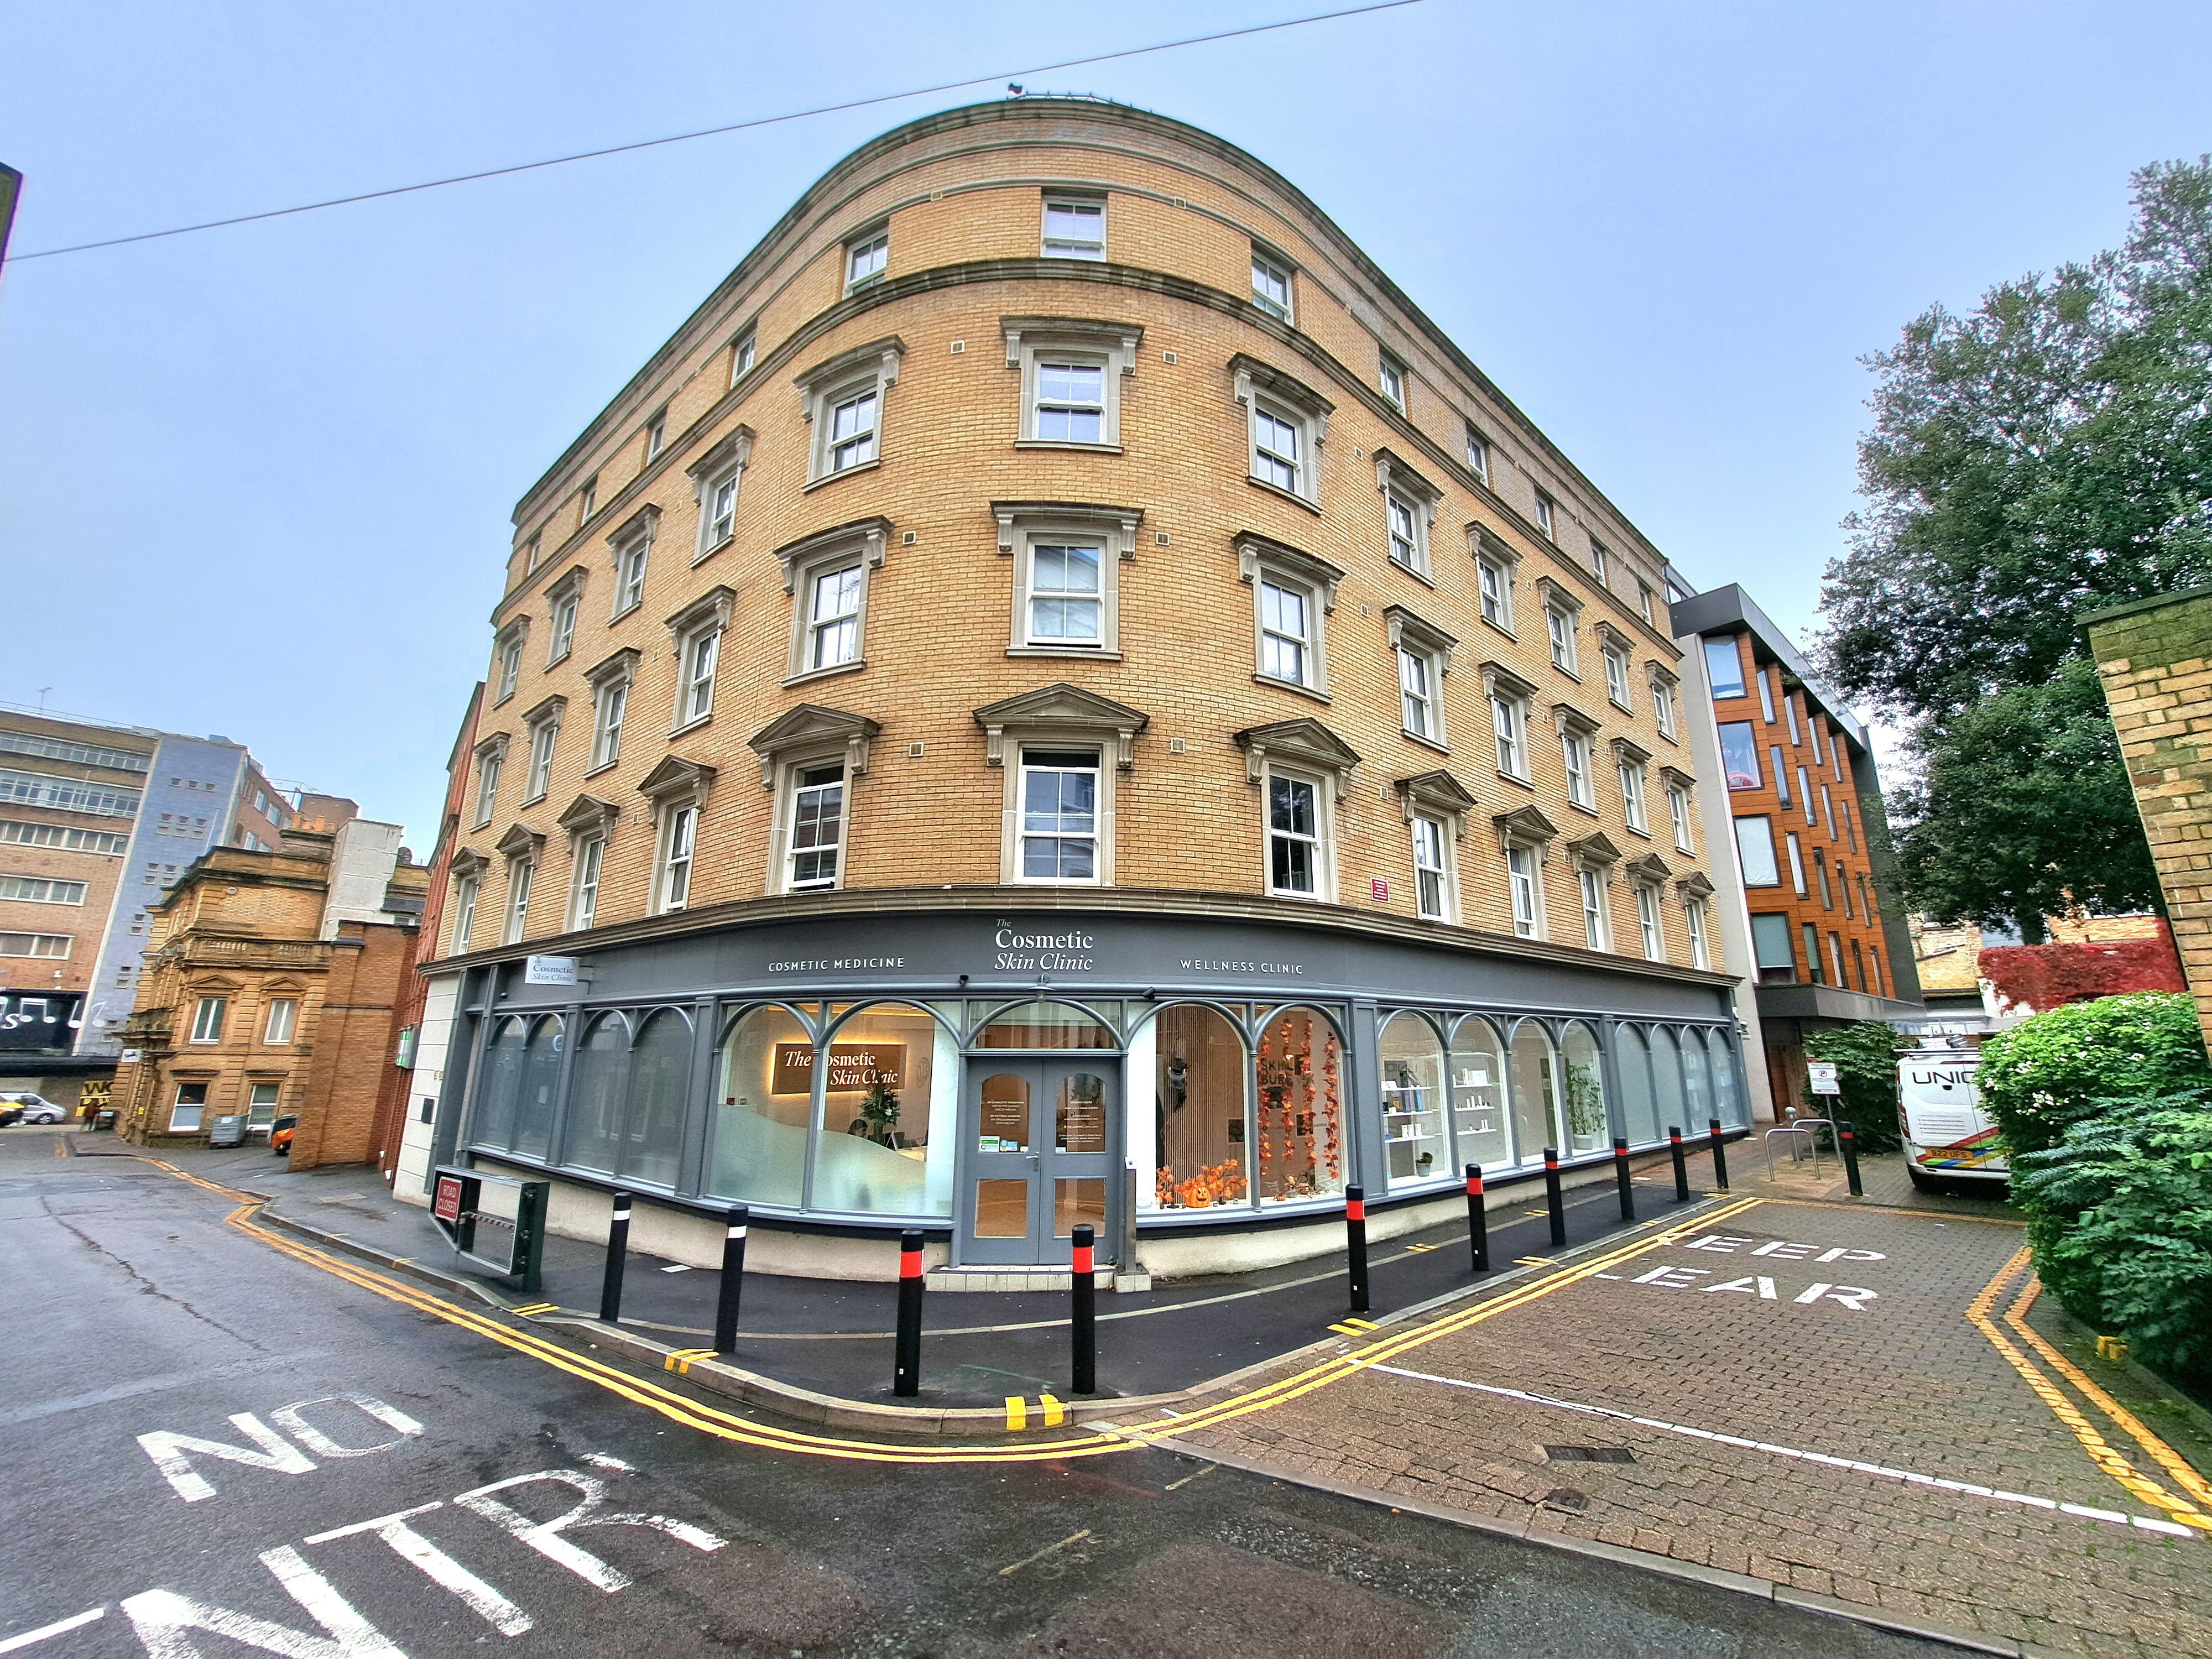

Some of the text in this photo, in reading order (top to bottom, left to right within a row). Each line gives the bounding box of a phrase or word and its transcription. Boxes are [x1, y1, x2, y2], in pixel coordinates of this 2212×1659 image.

[997, 919, 1011, 927] The
[995, 929, 1093, 949] Cosmetic
[533, 964, 573, 973] Cosmetic
[769, 957, 905, 972] COSMETIC MEDICINE
[994, 952, 1093, 971] Skin Clinic
[1180, 959, 1302, 974] WELLNESS CLINIC
[785, 1051, 875, 1067] The osmetic
[830, 1069, 898, 1086] Skin Clnic
[443, 1185, 456, 1198] ROAD
[438, 1198, 457, 1213] CLOSED
[1595, 1265, 1879, 1311] EAR
[137, 1392, 426, 1503] NO
